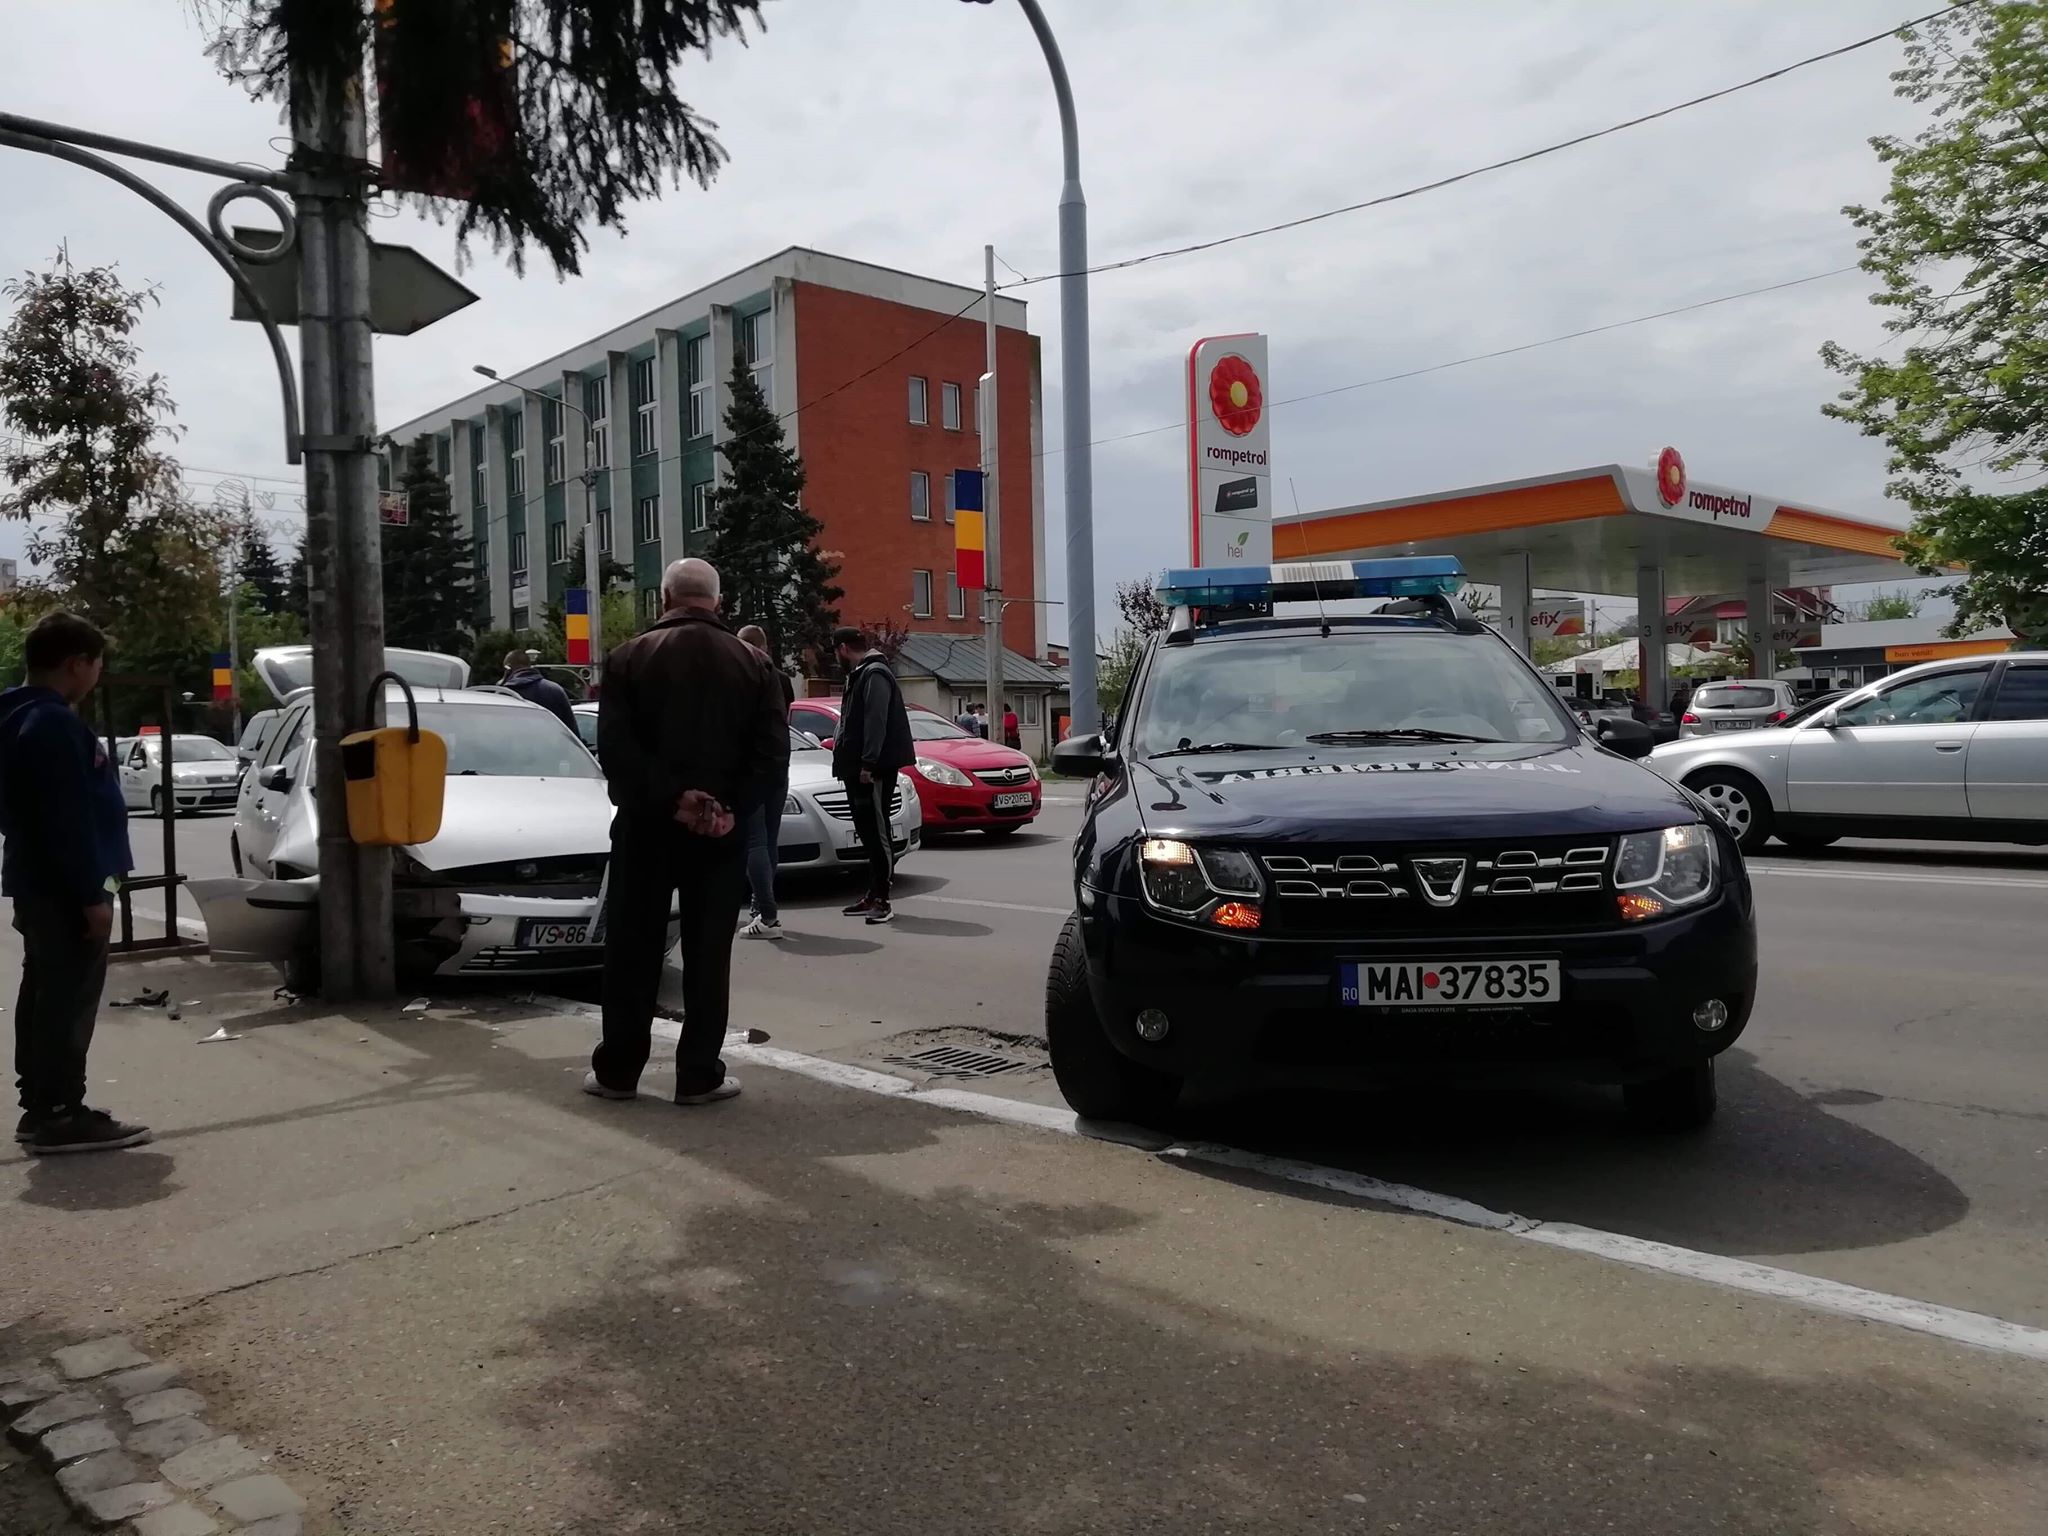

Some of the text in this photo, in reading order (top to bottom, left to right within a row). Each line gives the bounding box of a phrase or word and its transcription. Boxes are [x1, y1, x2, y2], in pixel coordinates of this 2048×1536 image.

[1207, 446, 1267, 467] rompetrol
[1689, 490, 1751, 521] rompetrol
[1227, 542, 1244, 558] hei
[1507, 615, 1514, 629] 1
[1530, 610, 1561, 629] efix
[1644, 625, 1652, 638] 3
[1665, 620, 1695, 637] efix
[1772, 628, 1801, 643] efix
[1753, 632, 1761, 644] 5
[1342, 987, 1358, 1001] RO
